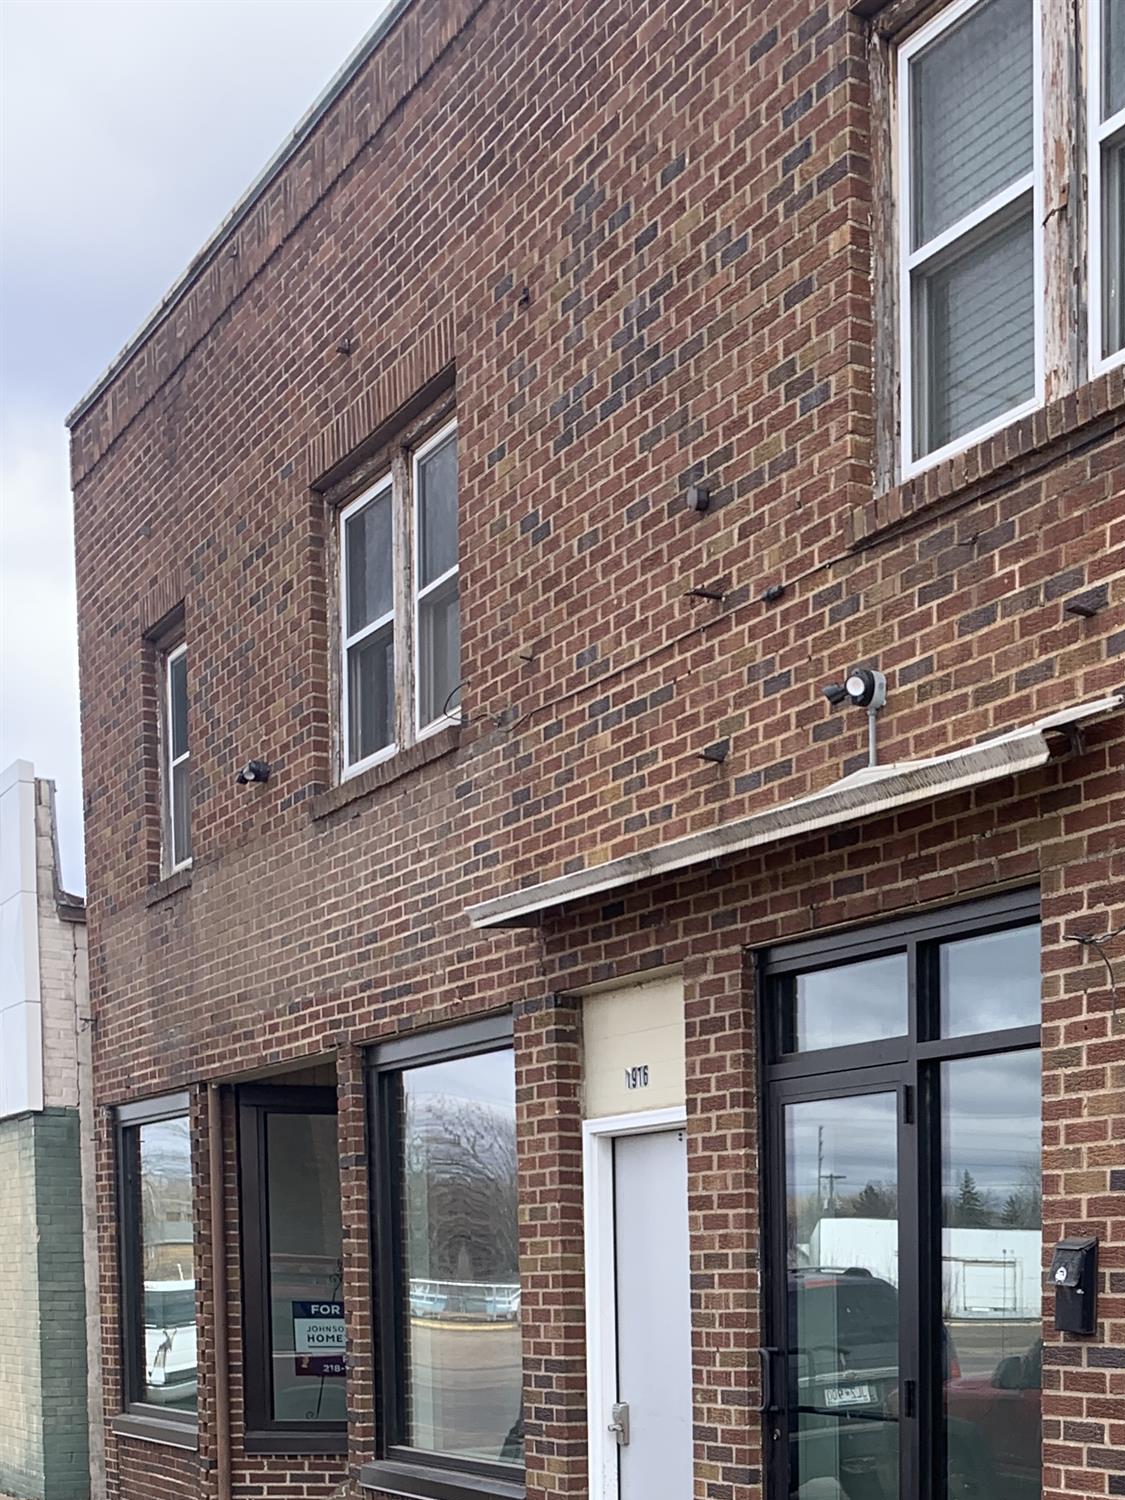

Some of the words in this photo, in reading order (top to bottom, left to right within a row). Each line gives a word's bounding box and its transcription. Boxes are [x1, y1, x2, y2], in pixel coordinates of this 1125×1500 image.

[625, 1065, 649, 1090] 1916
[311, 1304, 340, 1314] FOR
[307, 1334, 343, 1343] HOME
